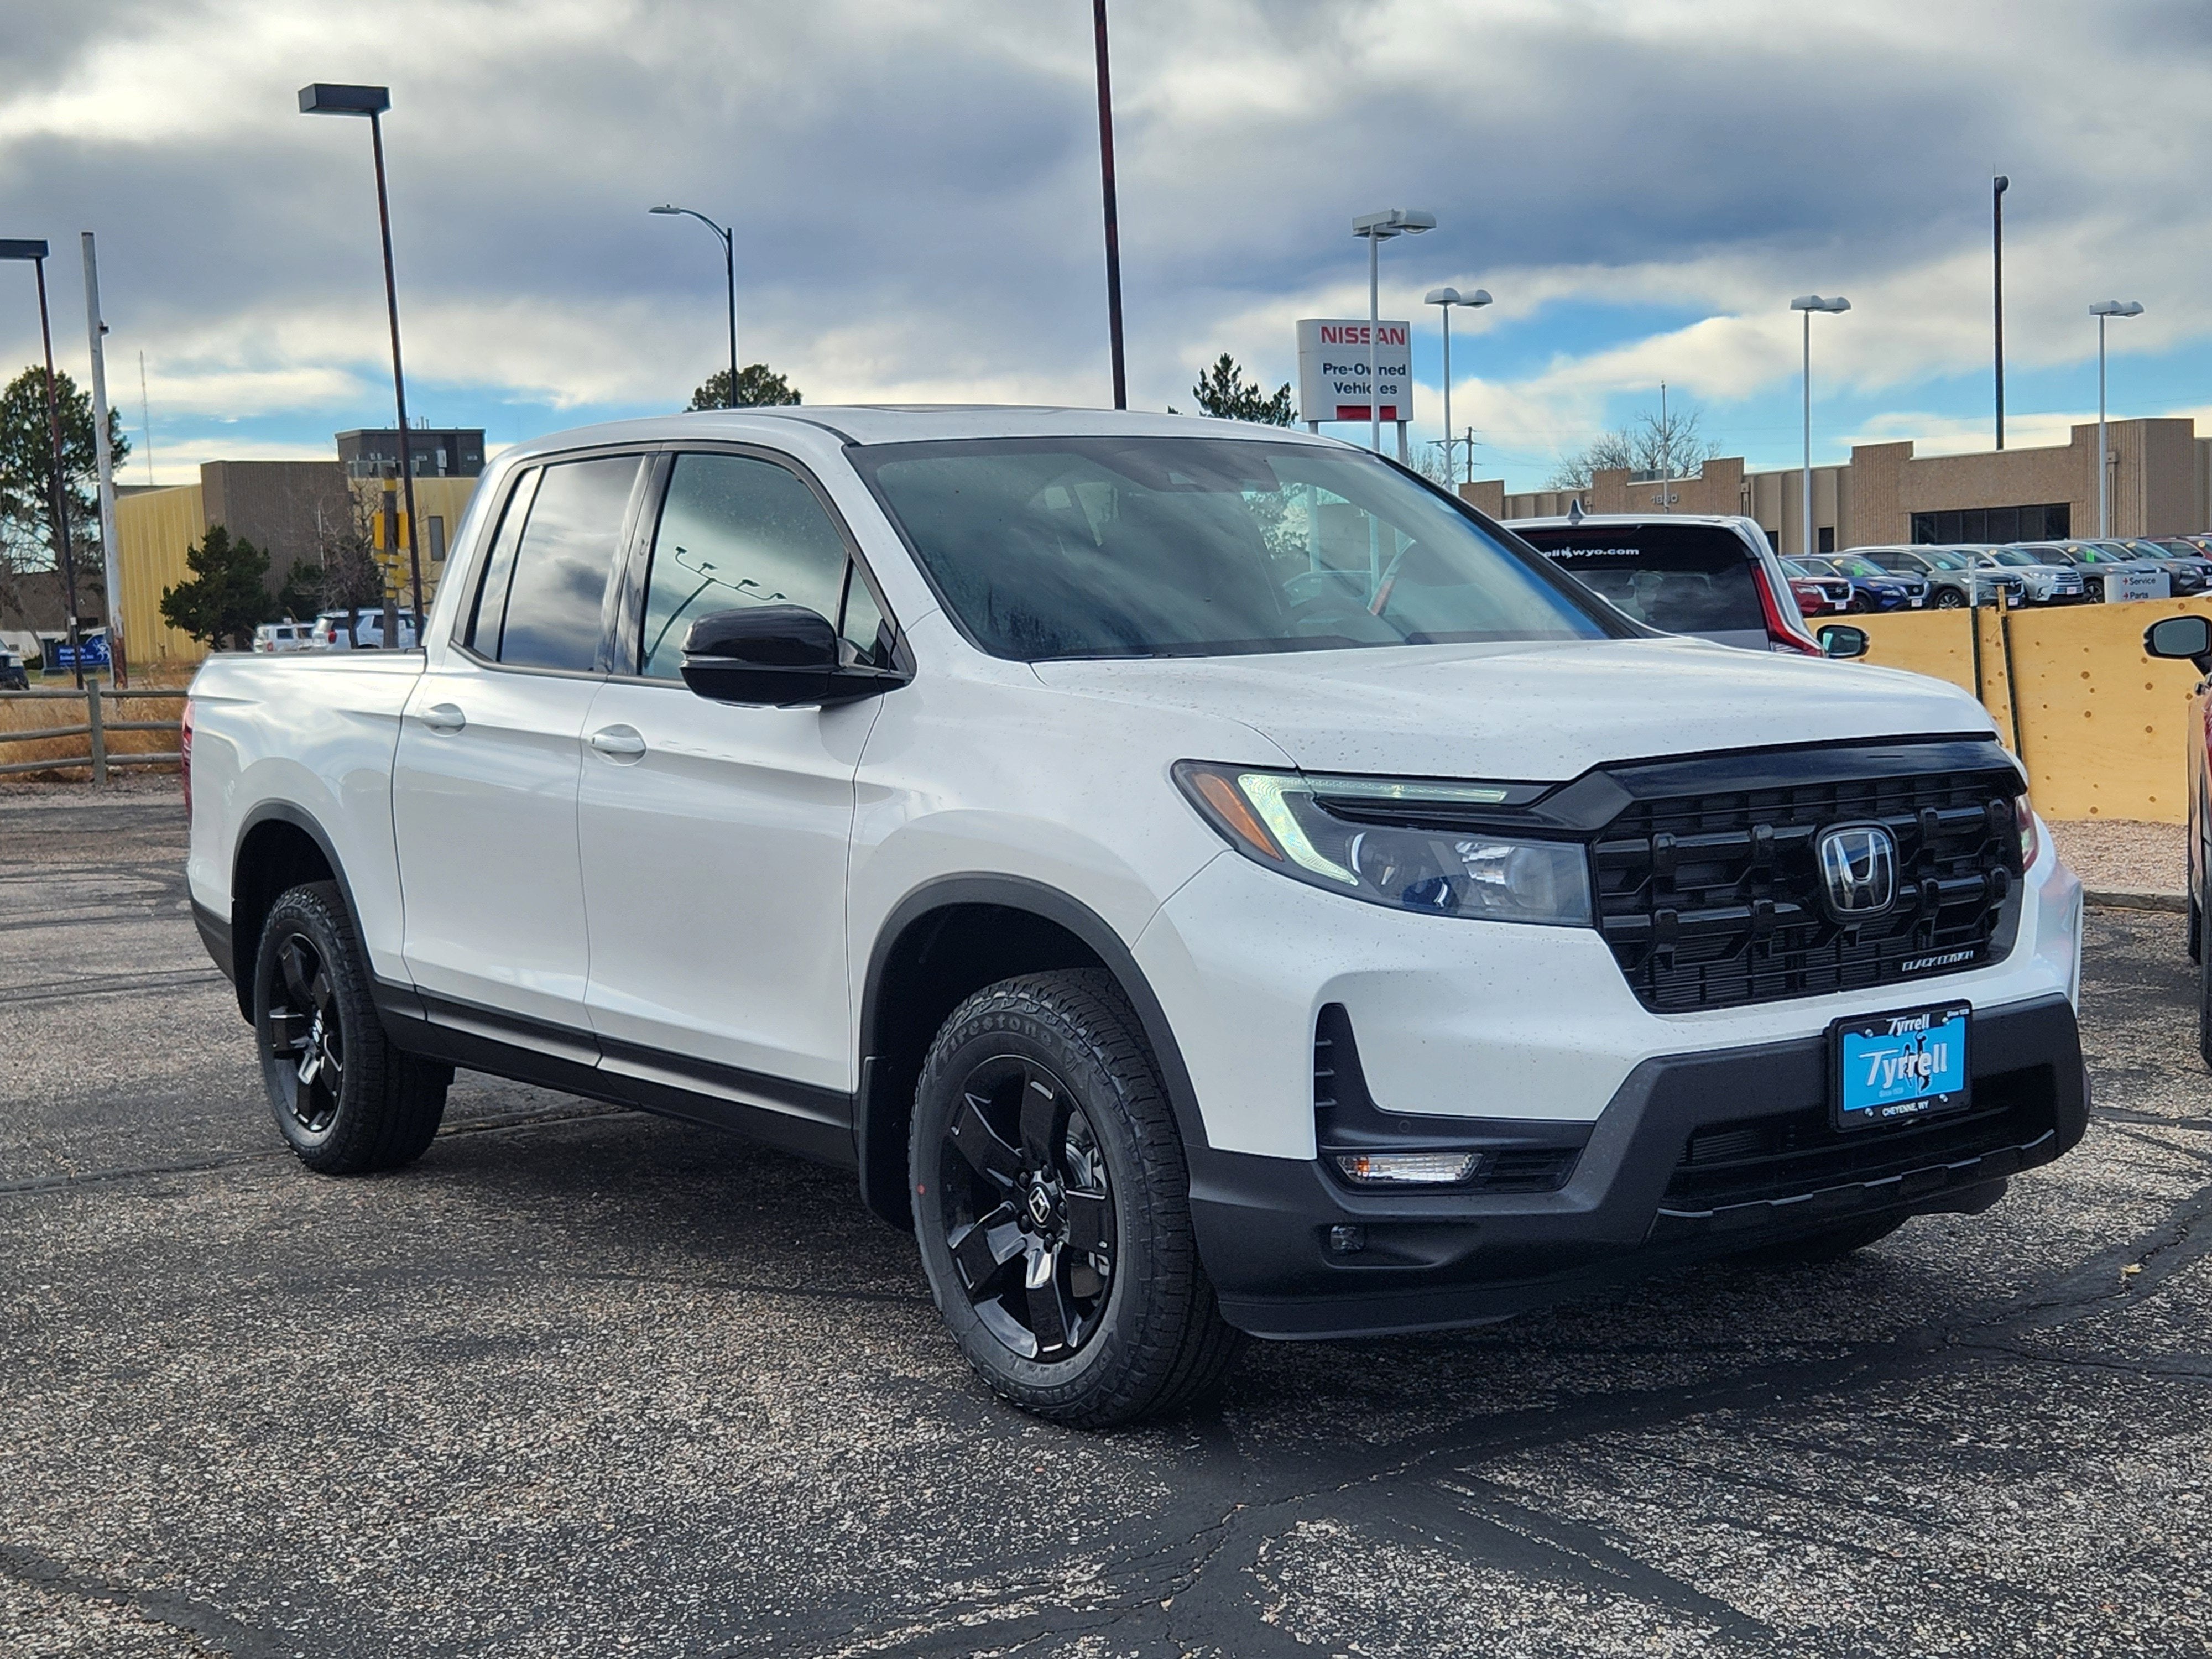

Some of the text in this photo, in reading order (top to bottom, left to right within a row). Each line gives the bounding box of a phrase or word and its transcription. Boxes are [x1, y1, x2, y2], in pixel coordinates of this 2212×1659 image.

[1321, 326, 1405, 345] NISSAN
[1333, 382, 1397, 394] Vehices
[1886, 1013, 1930, 1036] Tyrrell
[1859, 1042, 1948, 1089] Tyrrell
